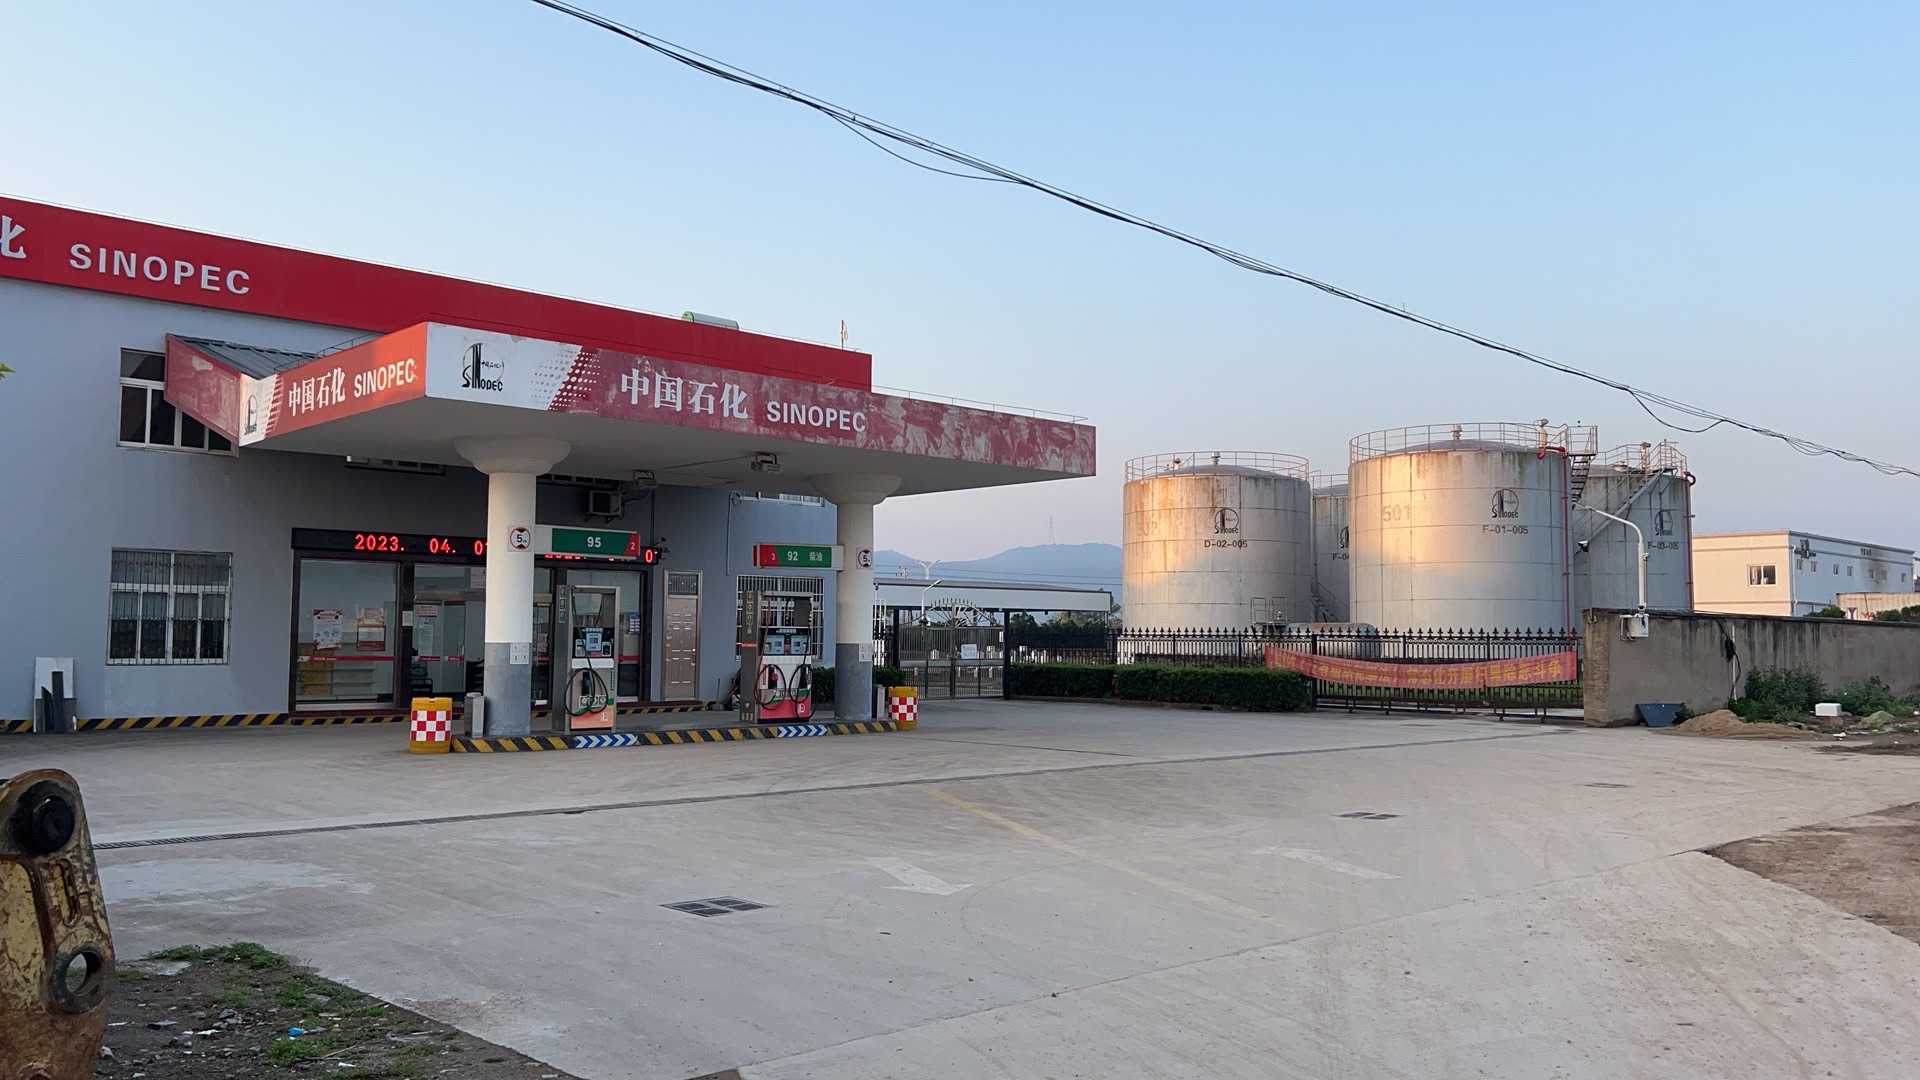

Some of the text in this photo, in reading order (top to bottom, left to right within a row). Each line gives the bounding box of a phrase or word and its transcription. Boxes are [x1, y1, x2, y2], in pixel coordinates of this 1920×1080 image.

[69, 243, 250, 295] SINOPEC
[354, 358, 415, 398] SINOPEC
[288, 367, 346, 417] 中国石化
[620, 368, 749, 419] 中国石化
[766, 401, 867, 433] SINOPEC
[1482, 525, 1529, 535] F-01-005
[354, 533, 487, 555] 2023. 04. 0
[587, 536, 602, 548] 95
[631, 542, 636, 550] 2
[1204, 539, 1248, 549] D-02-005
[771, 552, 776, 561] 3
[787, 551, 823, 562] 92 柴油
